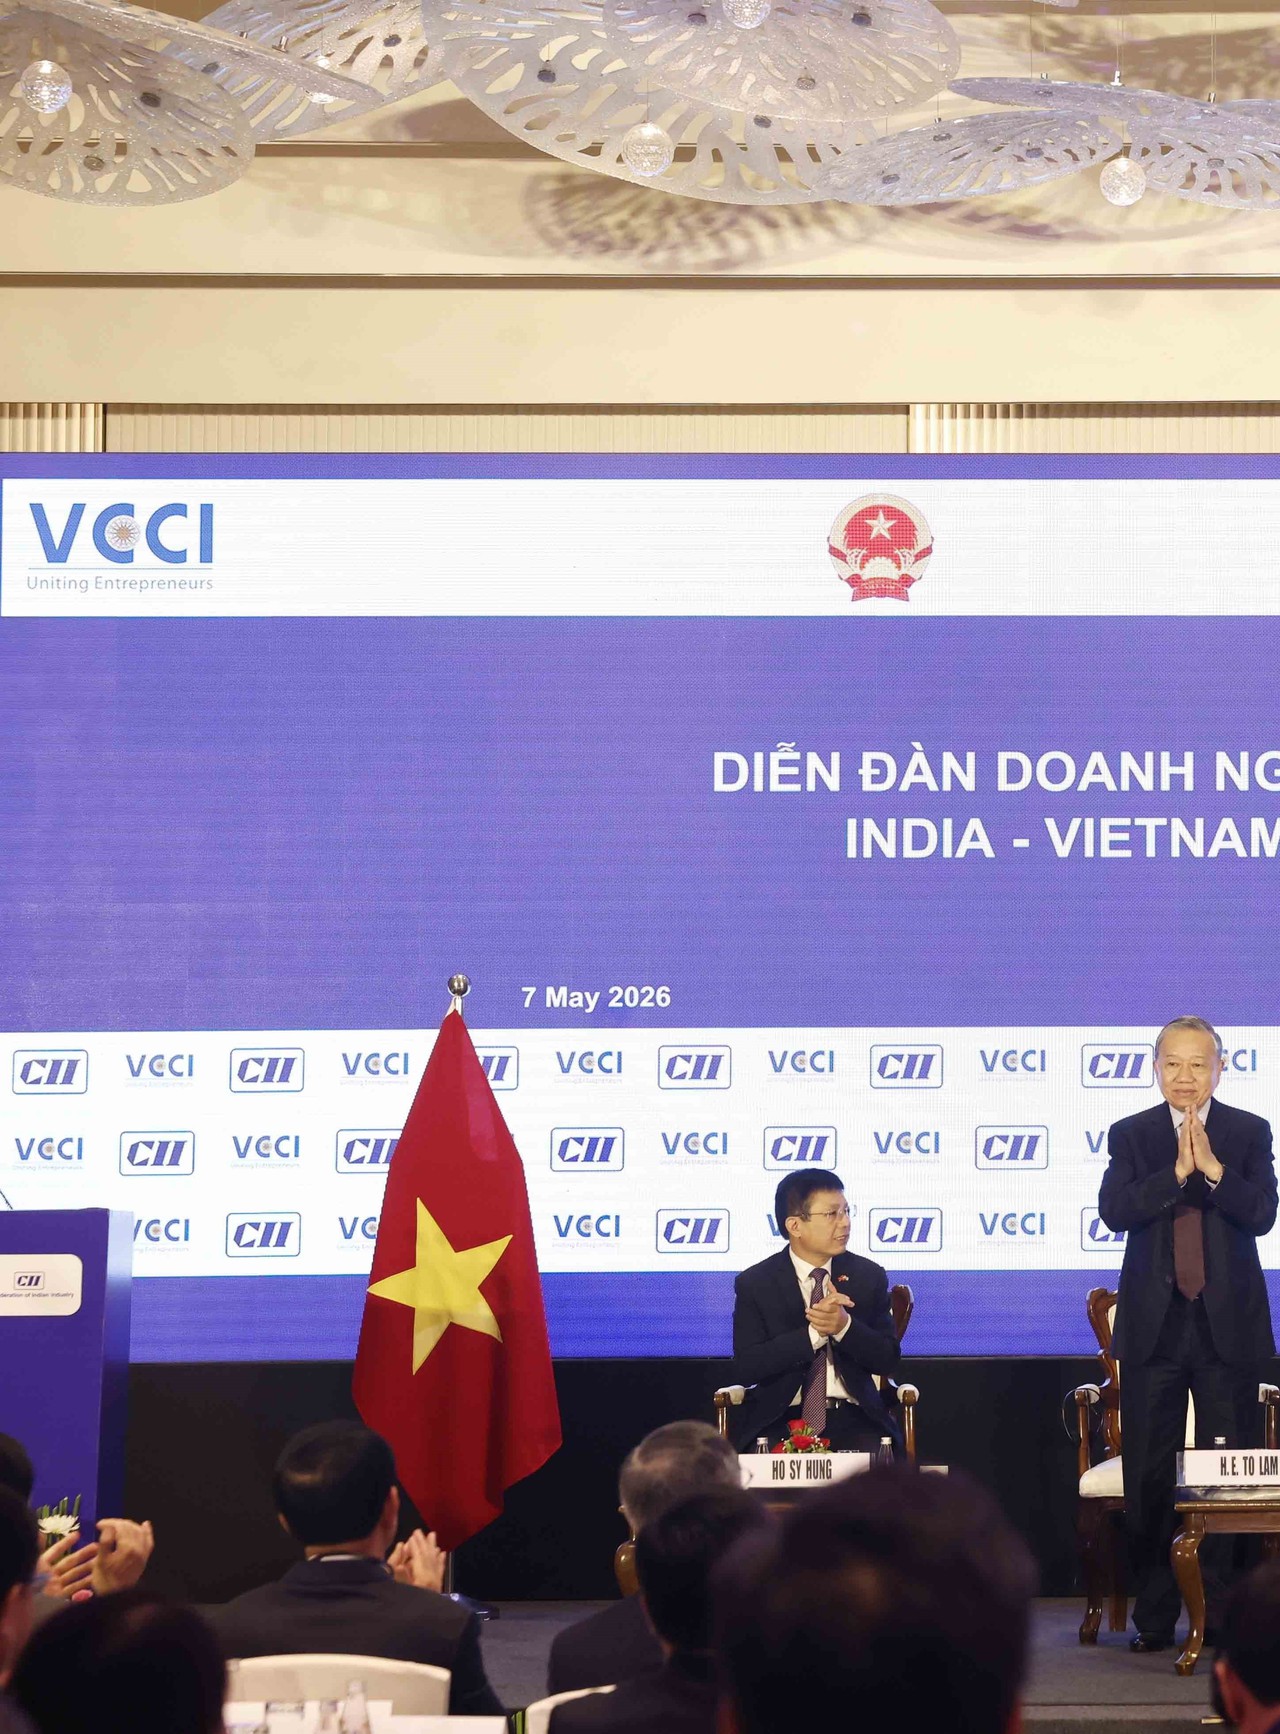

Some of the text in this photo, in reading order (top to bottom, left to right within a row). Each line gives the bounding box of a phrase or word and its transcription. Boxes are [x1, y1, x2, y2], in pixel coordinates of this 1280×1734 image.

[29, 502, 214, 565] VCCI
[26, 576, 214, 593] Uniting Entrepreneurs
[713, 742, 840, 792] DIỄN
[858, 741, 976, 792] ĐÀN
[997, 750, 1194, 792] DOANH
[847, 817, 995, 858] INDIA
[521, 985, 671, 1013] 7 May 2026
[20, 1059, 80, 1085] CII
[126, 1055, 194, 1077] VCCI
[237, 1057, 296, 1083] CII
[342, 1053, 409, 1075] VCCI
[556, 1051, 622, 1074] VCCI
[666, 1055, 724, 1080] CII
[768, 1050, 834, 1073] VCCI
[877, 1054, 935, 1079] CII
[980, 1050, 1046, 1072] VCCI
[1089, 1053, 1147, 1078] CII
[15, 1137, 83, 1160] VCCI
[127, 1141, 187, 1166] CII
[233, 1135, 299, 1158] VCCI
[558, 1137, 617, 1162] CII
[662, 1132, 727, 1155] VCCI
[771, 1136, 829, 1161] CII
[874, 1132, 939, 1154] VCCI
[983, 1135, 1040, 1160] CII
[233, 1222, 293, 1248] CII
[553, 1215, 620, 1237] VCCI
[663, 1218, 722, 1243] CII
[876, 1217, 934, 1243] CII
[979, 1213, 1045, 1236] VCCI
[17, 1275, 41, 1287] CII
[772, 1459, 832, 1480] HO SY HUNG
[1242, 1456, 1255, 1476] TO
[1259, 1455, 1279, 1476] LAM
